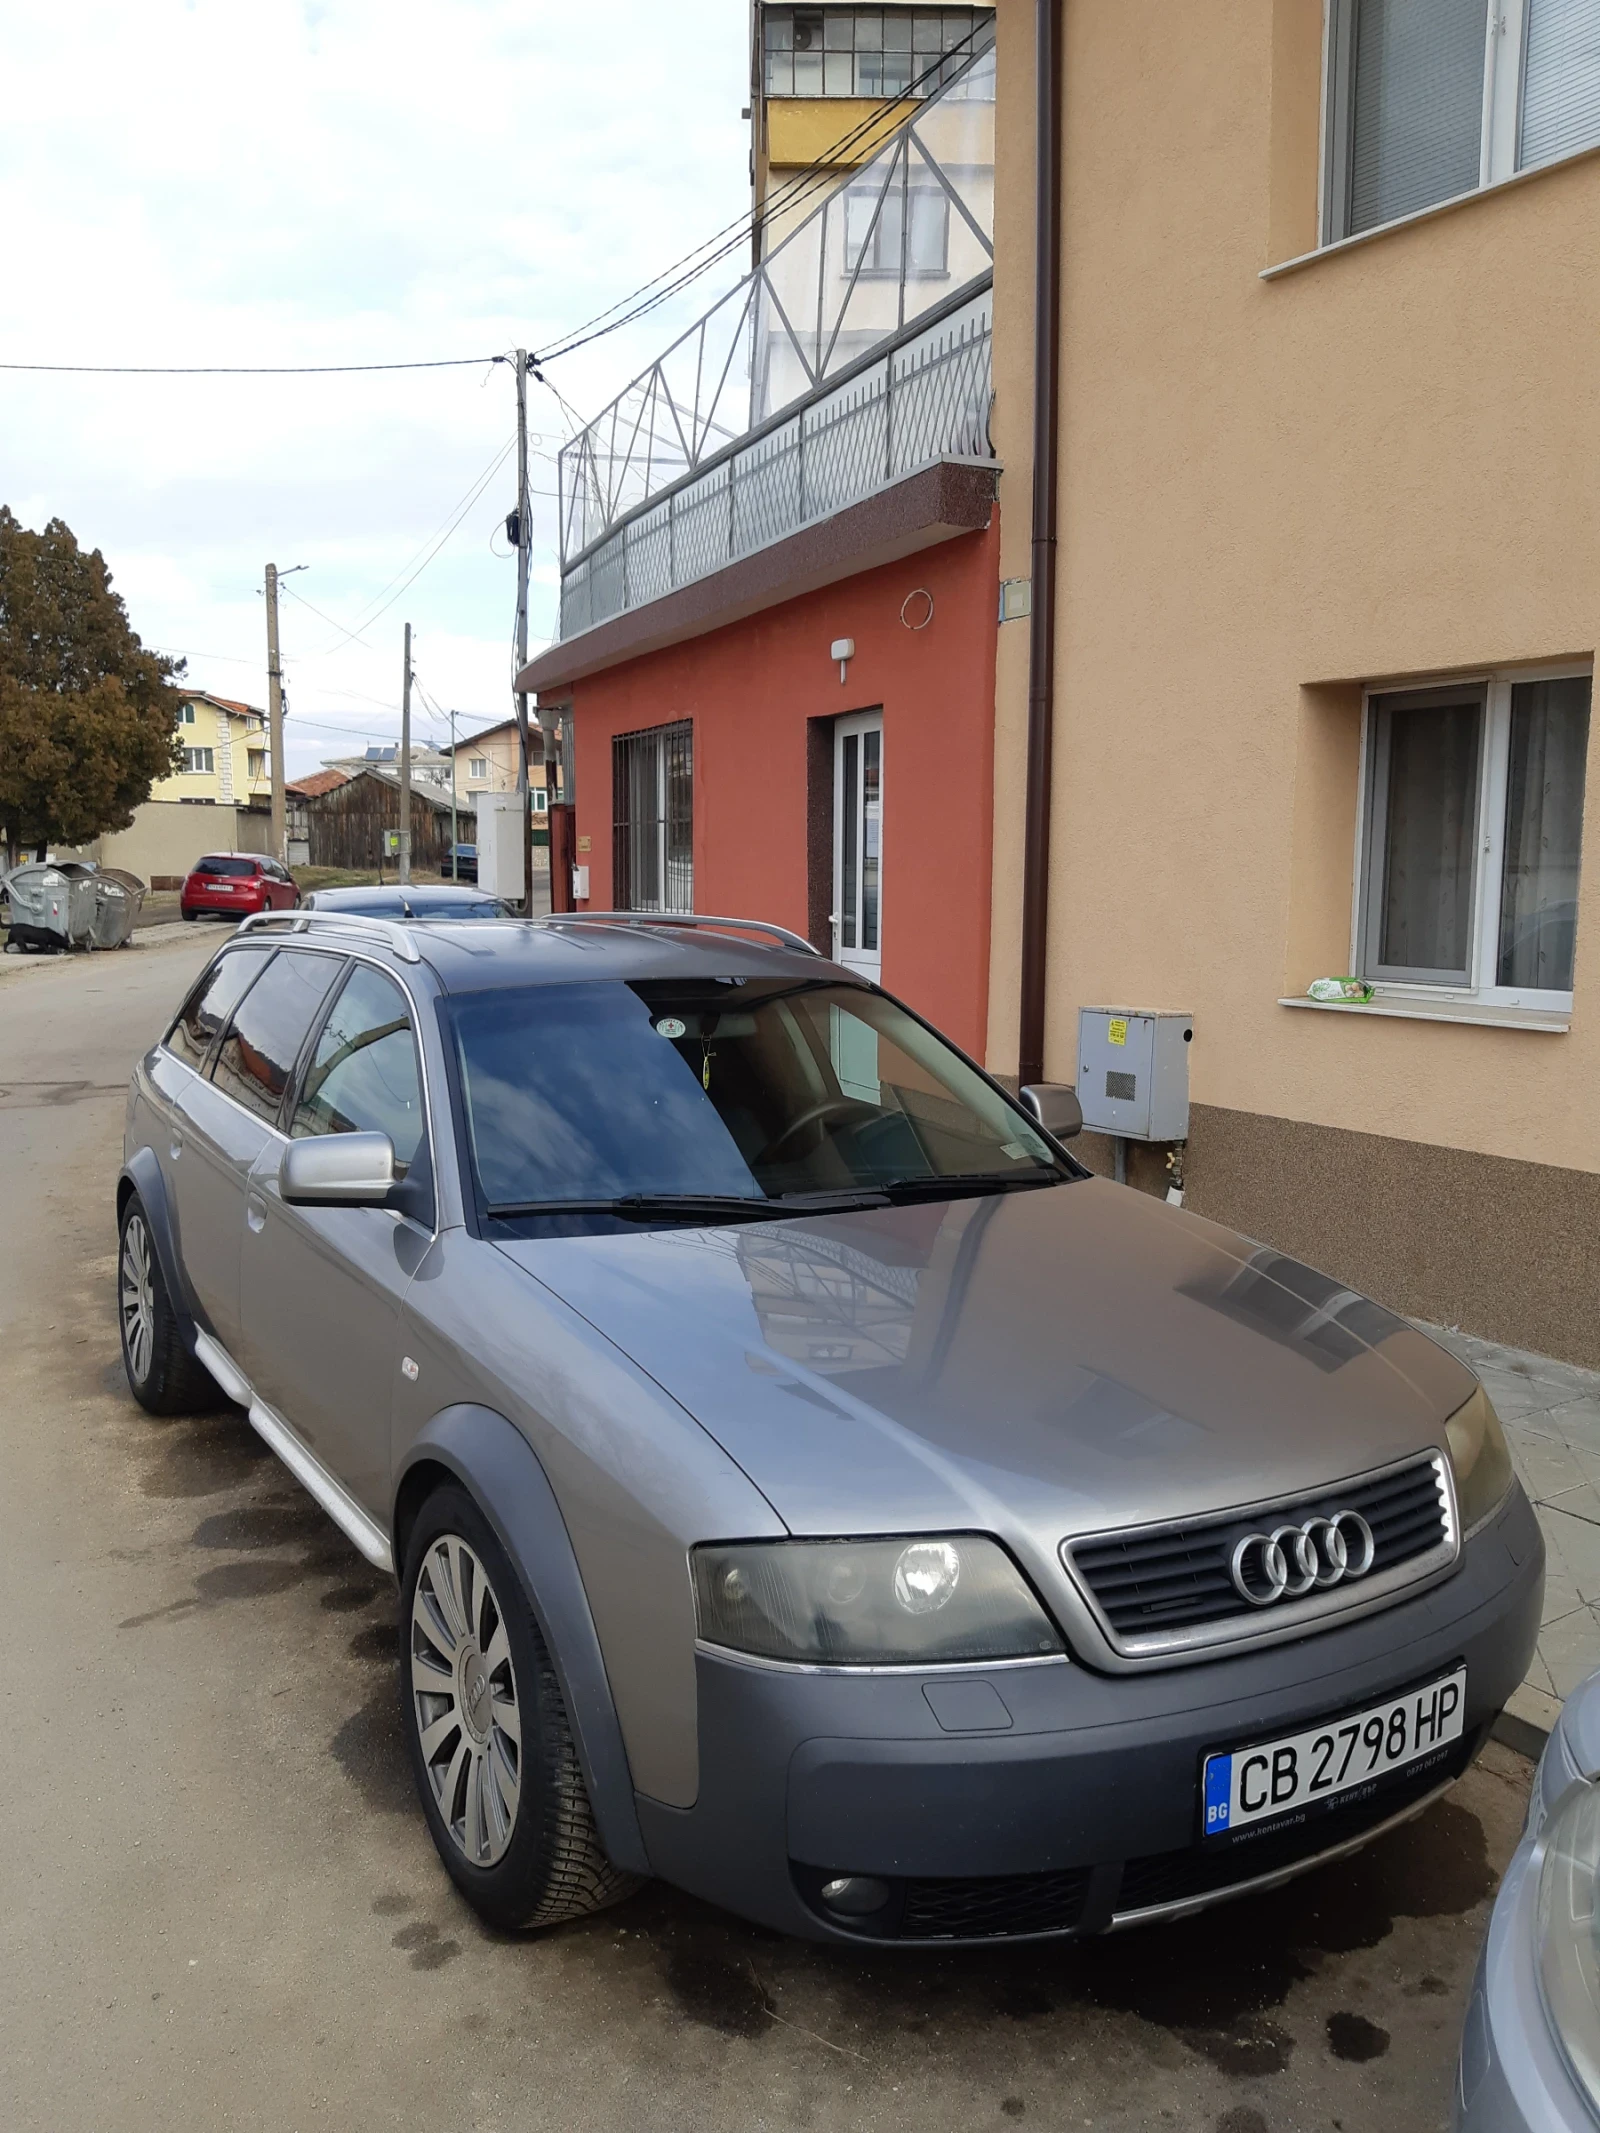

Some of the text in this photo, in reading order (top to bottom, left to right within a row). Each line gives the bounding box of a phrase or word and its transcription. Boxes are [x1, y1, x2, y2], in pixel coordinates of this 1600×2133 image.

[1239, 1681, 1459, 1813] CB 2798 HP
[1207, 1803, 1228, 1823] BG
